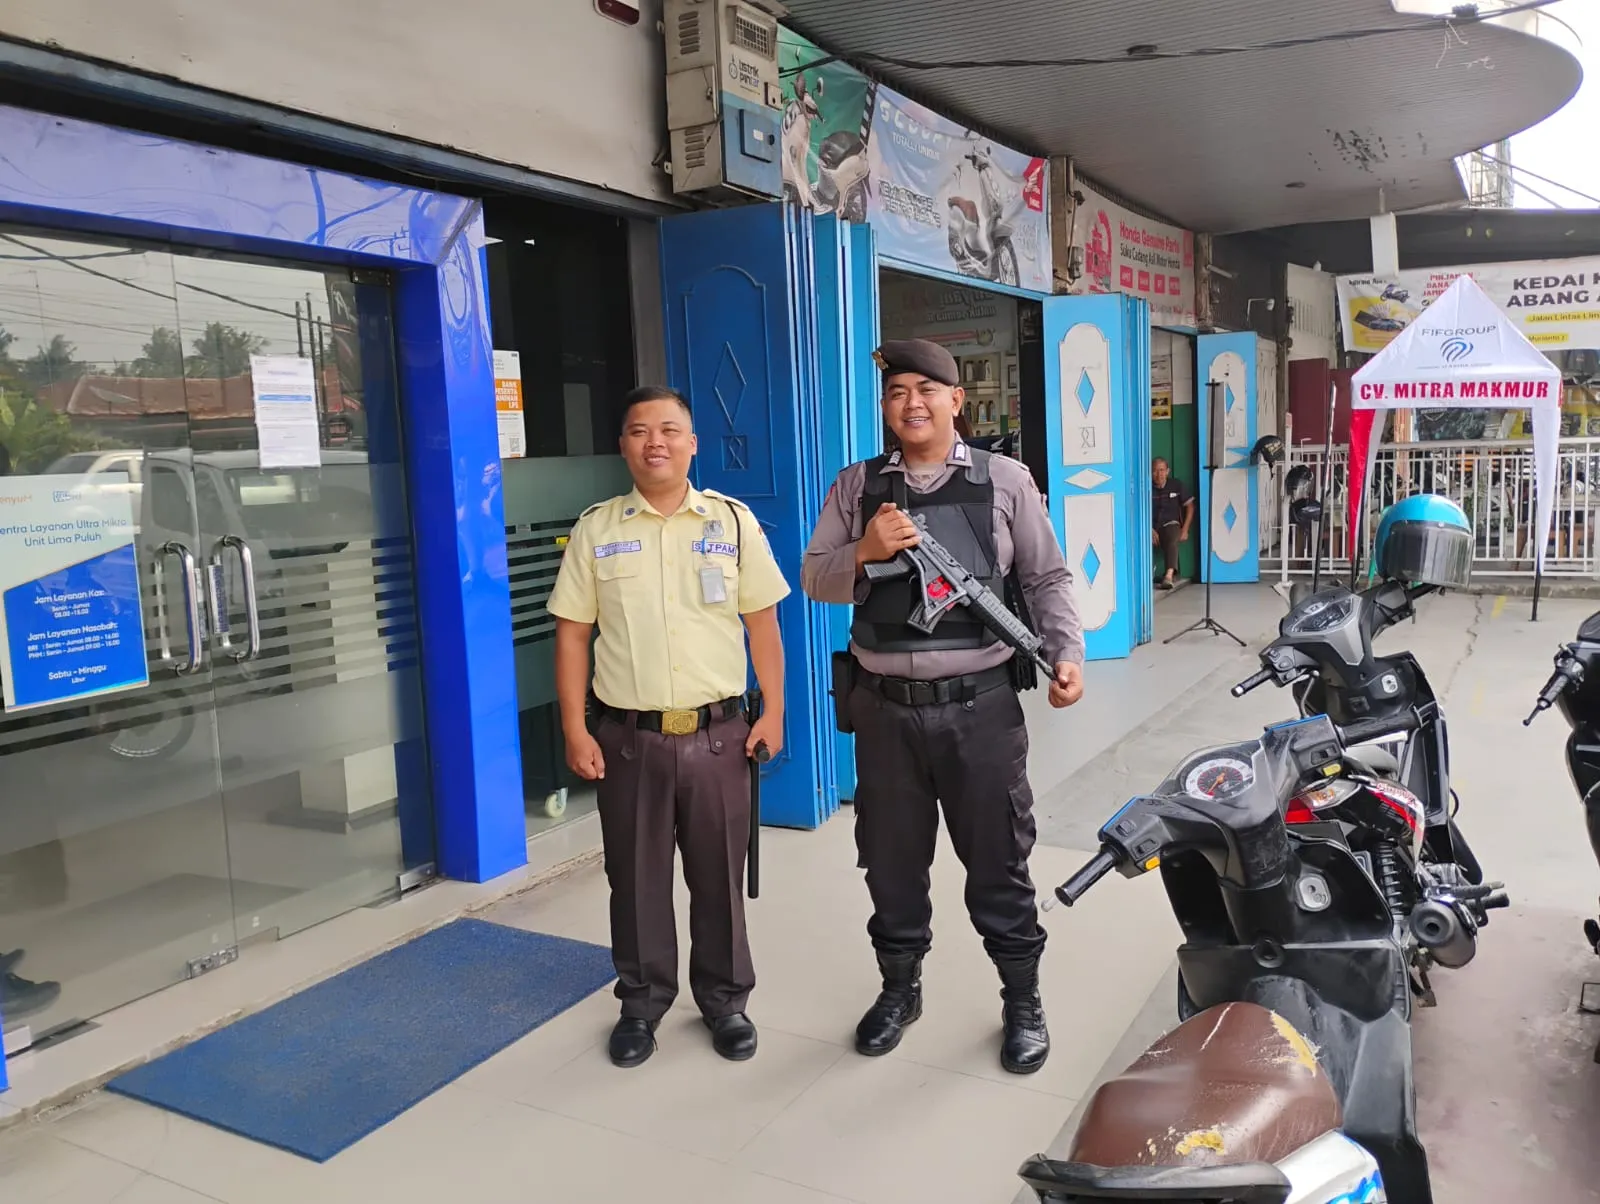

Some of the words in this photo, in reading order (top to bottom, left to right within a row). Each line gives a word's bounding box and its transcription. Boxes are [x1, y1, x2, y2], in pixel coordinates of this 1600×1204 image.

[1120, 220, 1140, 244] Honda
[1513, 274, 1584, 290] KEDAI
[1506, 290, 1589, 308] ABANG
[1421, 325, 1496, 336] FIFGROUP
[1360, 383, 1388, 400] CV.
[1394, 381, 1454, 400] MITRA
[1460, 380, 1548, 398] MAKMUR
[30, 522, 74, 534] Layanan
[76, 520, 99, 529] Ultra
[101, 518, 127, 527] Mikro
[24, 537, 45, 547] Unit
[48, 535, 72, 545] Lima
[74, 532, 102, 542] Puluh
[694, 542, 736, 554] STPAM
[34, 595, 52, 604] Jam
[53, 592, 88, 602] Layanan
[27, 632, 46, 641] Jam
[47, 628, 81, 639] Layanan
[48, 671, 72, 680] Sabtu
[78, 664, 107, 675] Minggu
